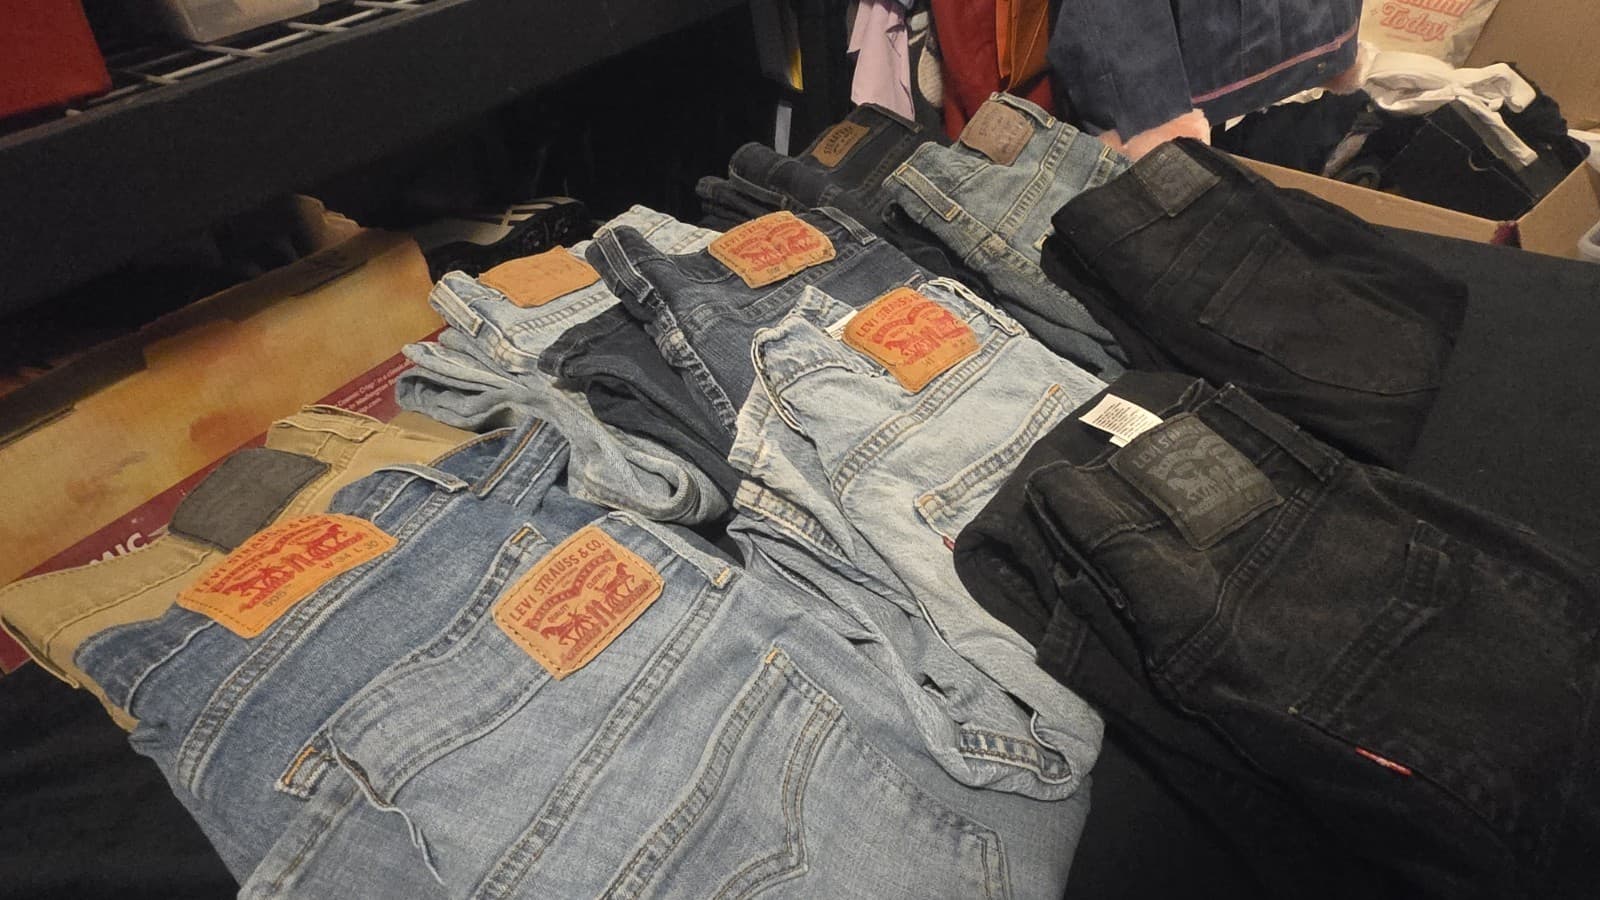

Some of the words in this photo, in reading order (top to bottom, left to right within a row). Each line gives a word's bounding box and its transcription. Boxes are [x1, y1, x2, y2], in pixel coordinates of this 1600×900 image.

[856, 319, 879, 338] LEVI
[509, 594, 537, 622] LEVI
[534, 554, 580, 595] STRAUSS
[578, 547, 589, 560] &
[587, 539, 605, 553] CO.
